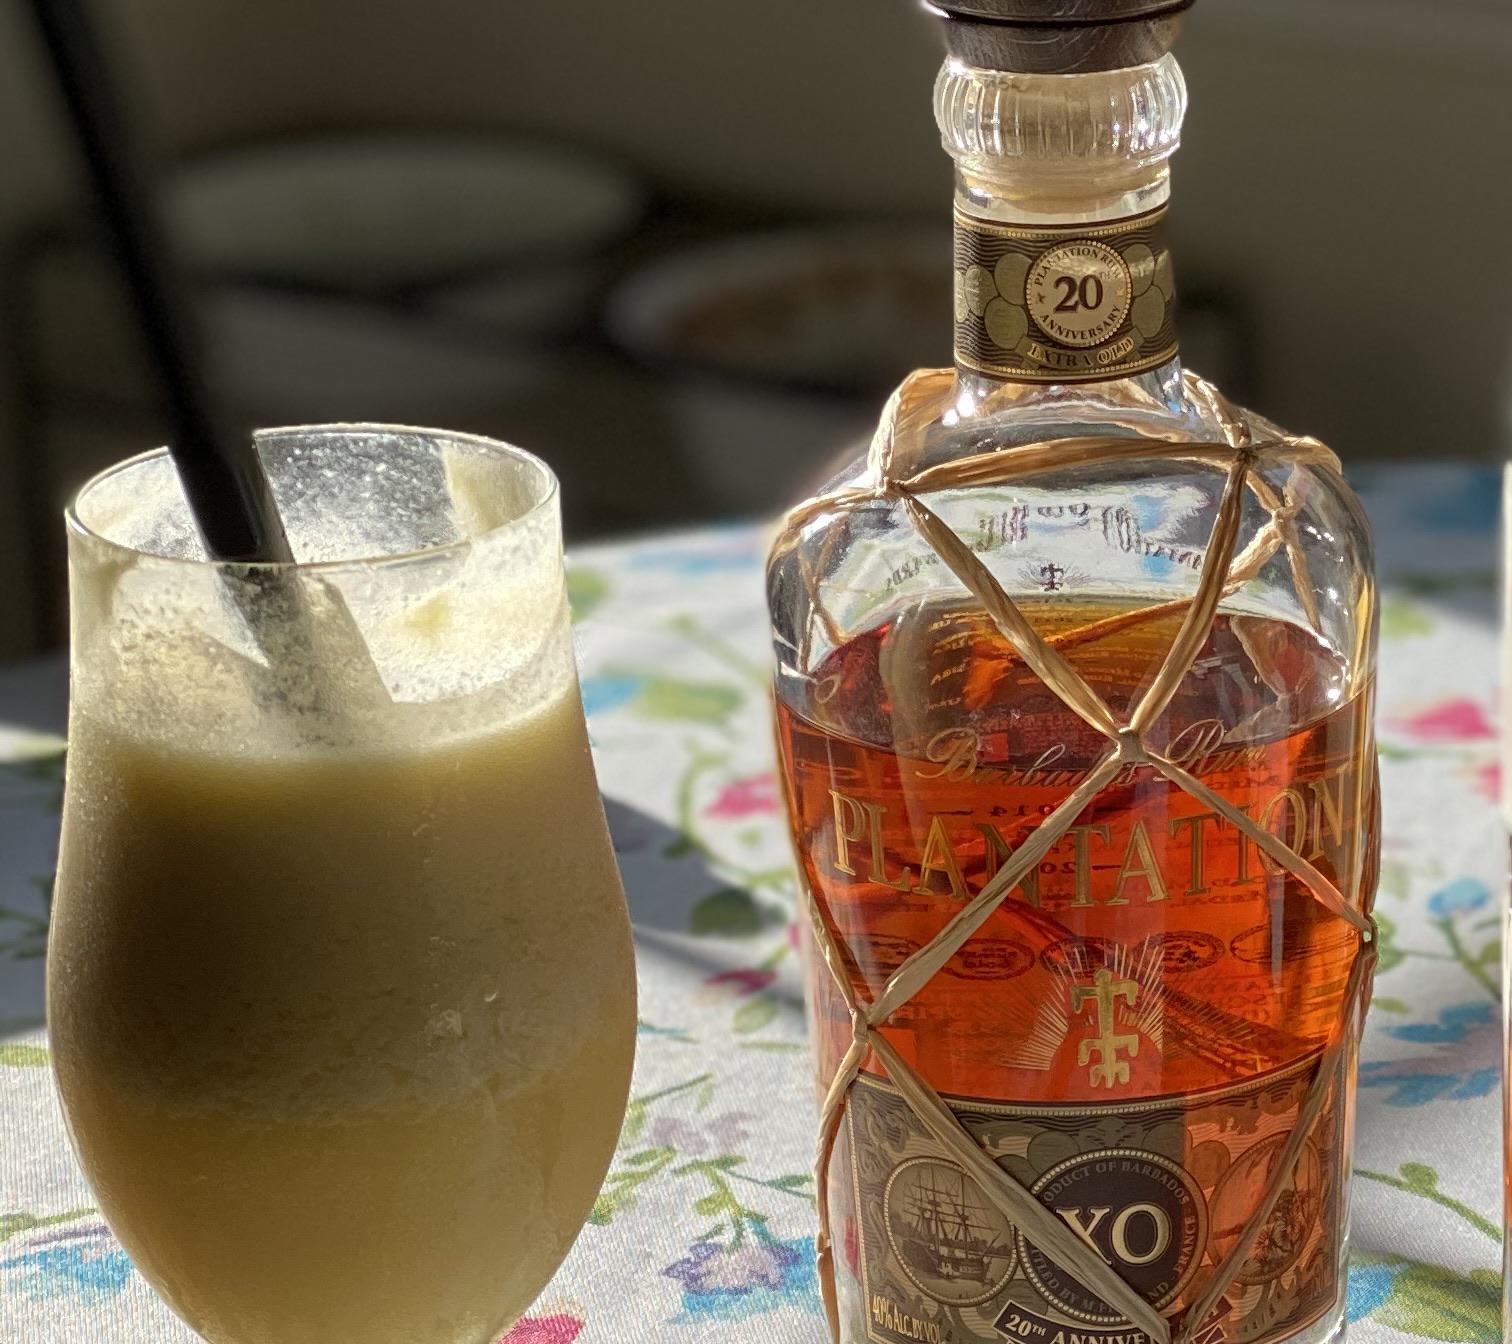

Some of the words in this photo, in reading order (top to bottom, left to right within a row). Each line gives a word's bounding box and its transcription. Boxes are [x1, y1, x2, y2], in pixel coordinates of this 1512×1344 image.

[1034, 247, 1098, 286] PLANTATION
[1040, 305, 1122, 340] ANNIVERSARY
[1043, 1165, 1092, 1203] ODUCT
[1096, 1160, 1118, 1174] OF
[1121, 1160, 1190, 1205] BARBADOS
[1055, 1203, 1171, 1267] XO
